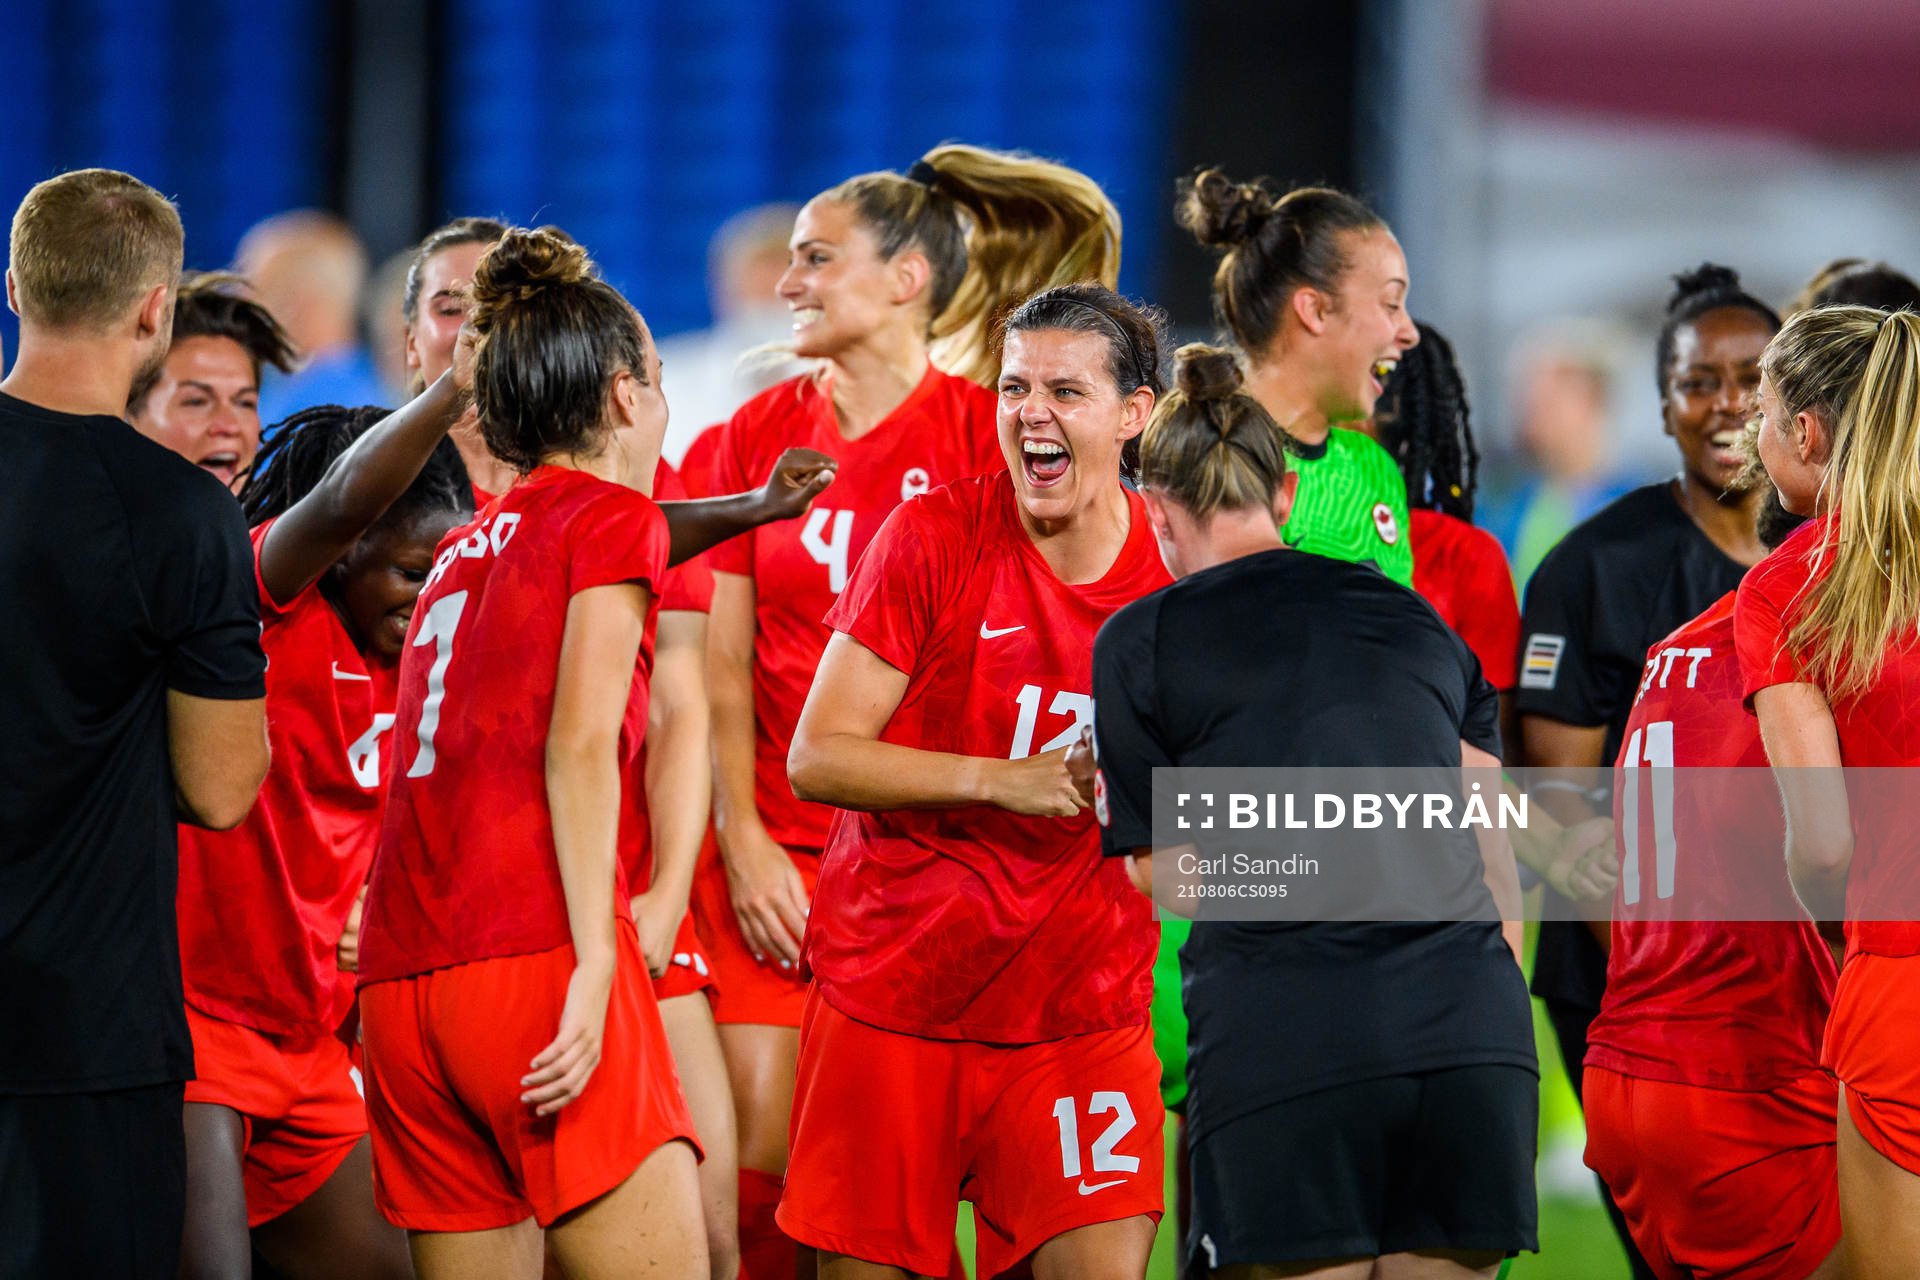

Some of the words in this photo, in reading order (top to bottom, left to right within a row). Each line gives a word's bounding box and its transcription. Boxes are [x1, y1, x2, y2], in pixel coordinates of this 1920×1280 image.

[801, 509, 854, 593] 4
[406, 589, 468, 778] 7
[1009, 684, 1092, 760] 12
[1622, 721, 1676, 905] 11
[1053, 1091, 1140, 1179] 12
